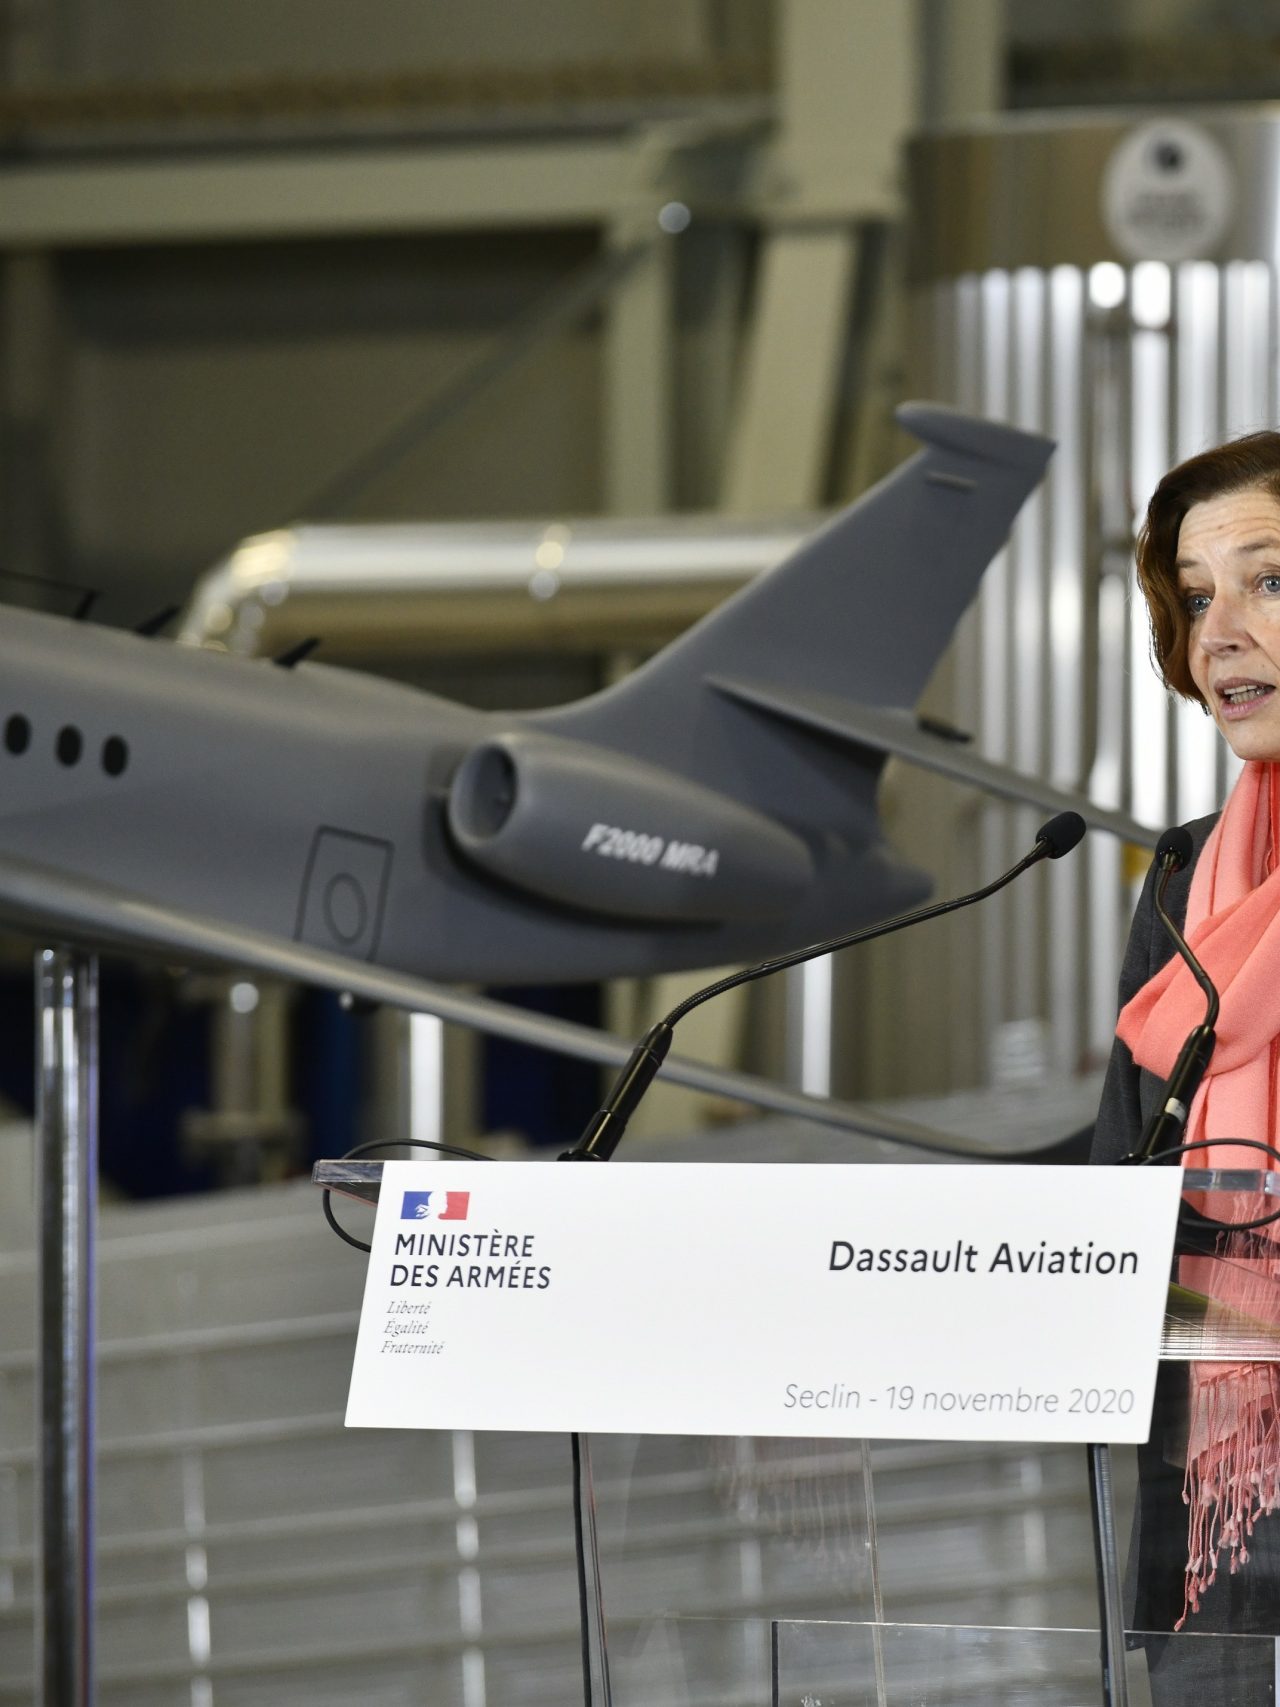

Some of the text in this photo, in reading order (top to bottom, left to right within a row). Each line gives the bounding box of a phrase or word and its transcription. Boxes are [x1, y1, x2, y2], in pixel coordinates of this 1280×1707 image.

[581, 822, 720, 879] F2000 MRA
[394, 1228, 535, 1258] MINISTÈRE
[829, 1240, 1139, 1275] Dassault Aviation
[389, 1260, 552, 1290] DES ARMÉES
[386, 1300, 431, 1315] Liberté
[383, 1318, 430, 1337] Égalité
[379, 1340, 445, 1355] Fraternité
[783, 1383, 861, 1409] Seclin
[886, 1386, 915, 1411] 19
[922, 1387, 1059, 1413] novembre
[1067, 1388, 1135, 1414] 2020
